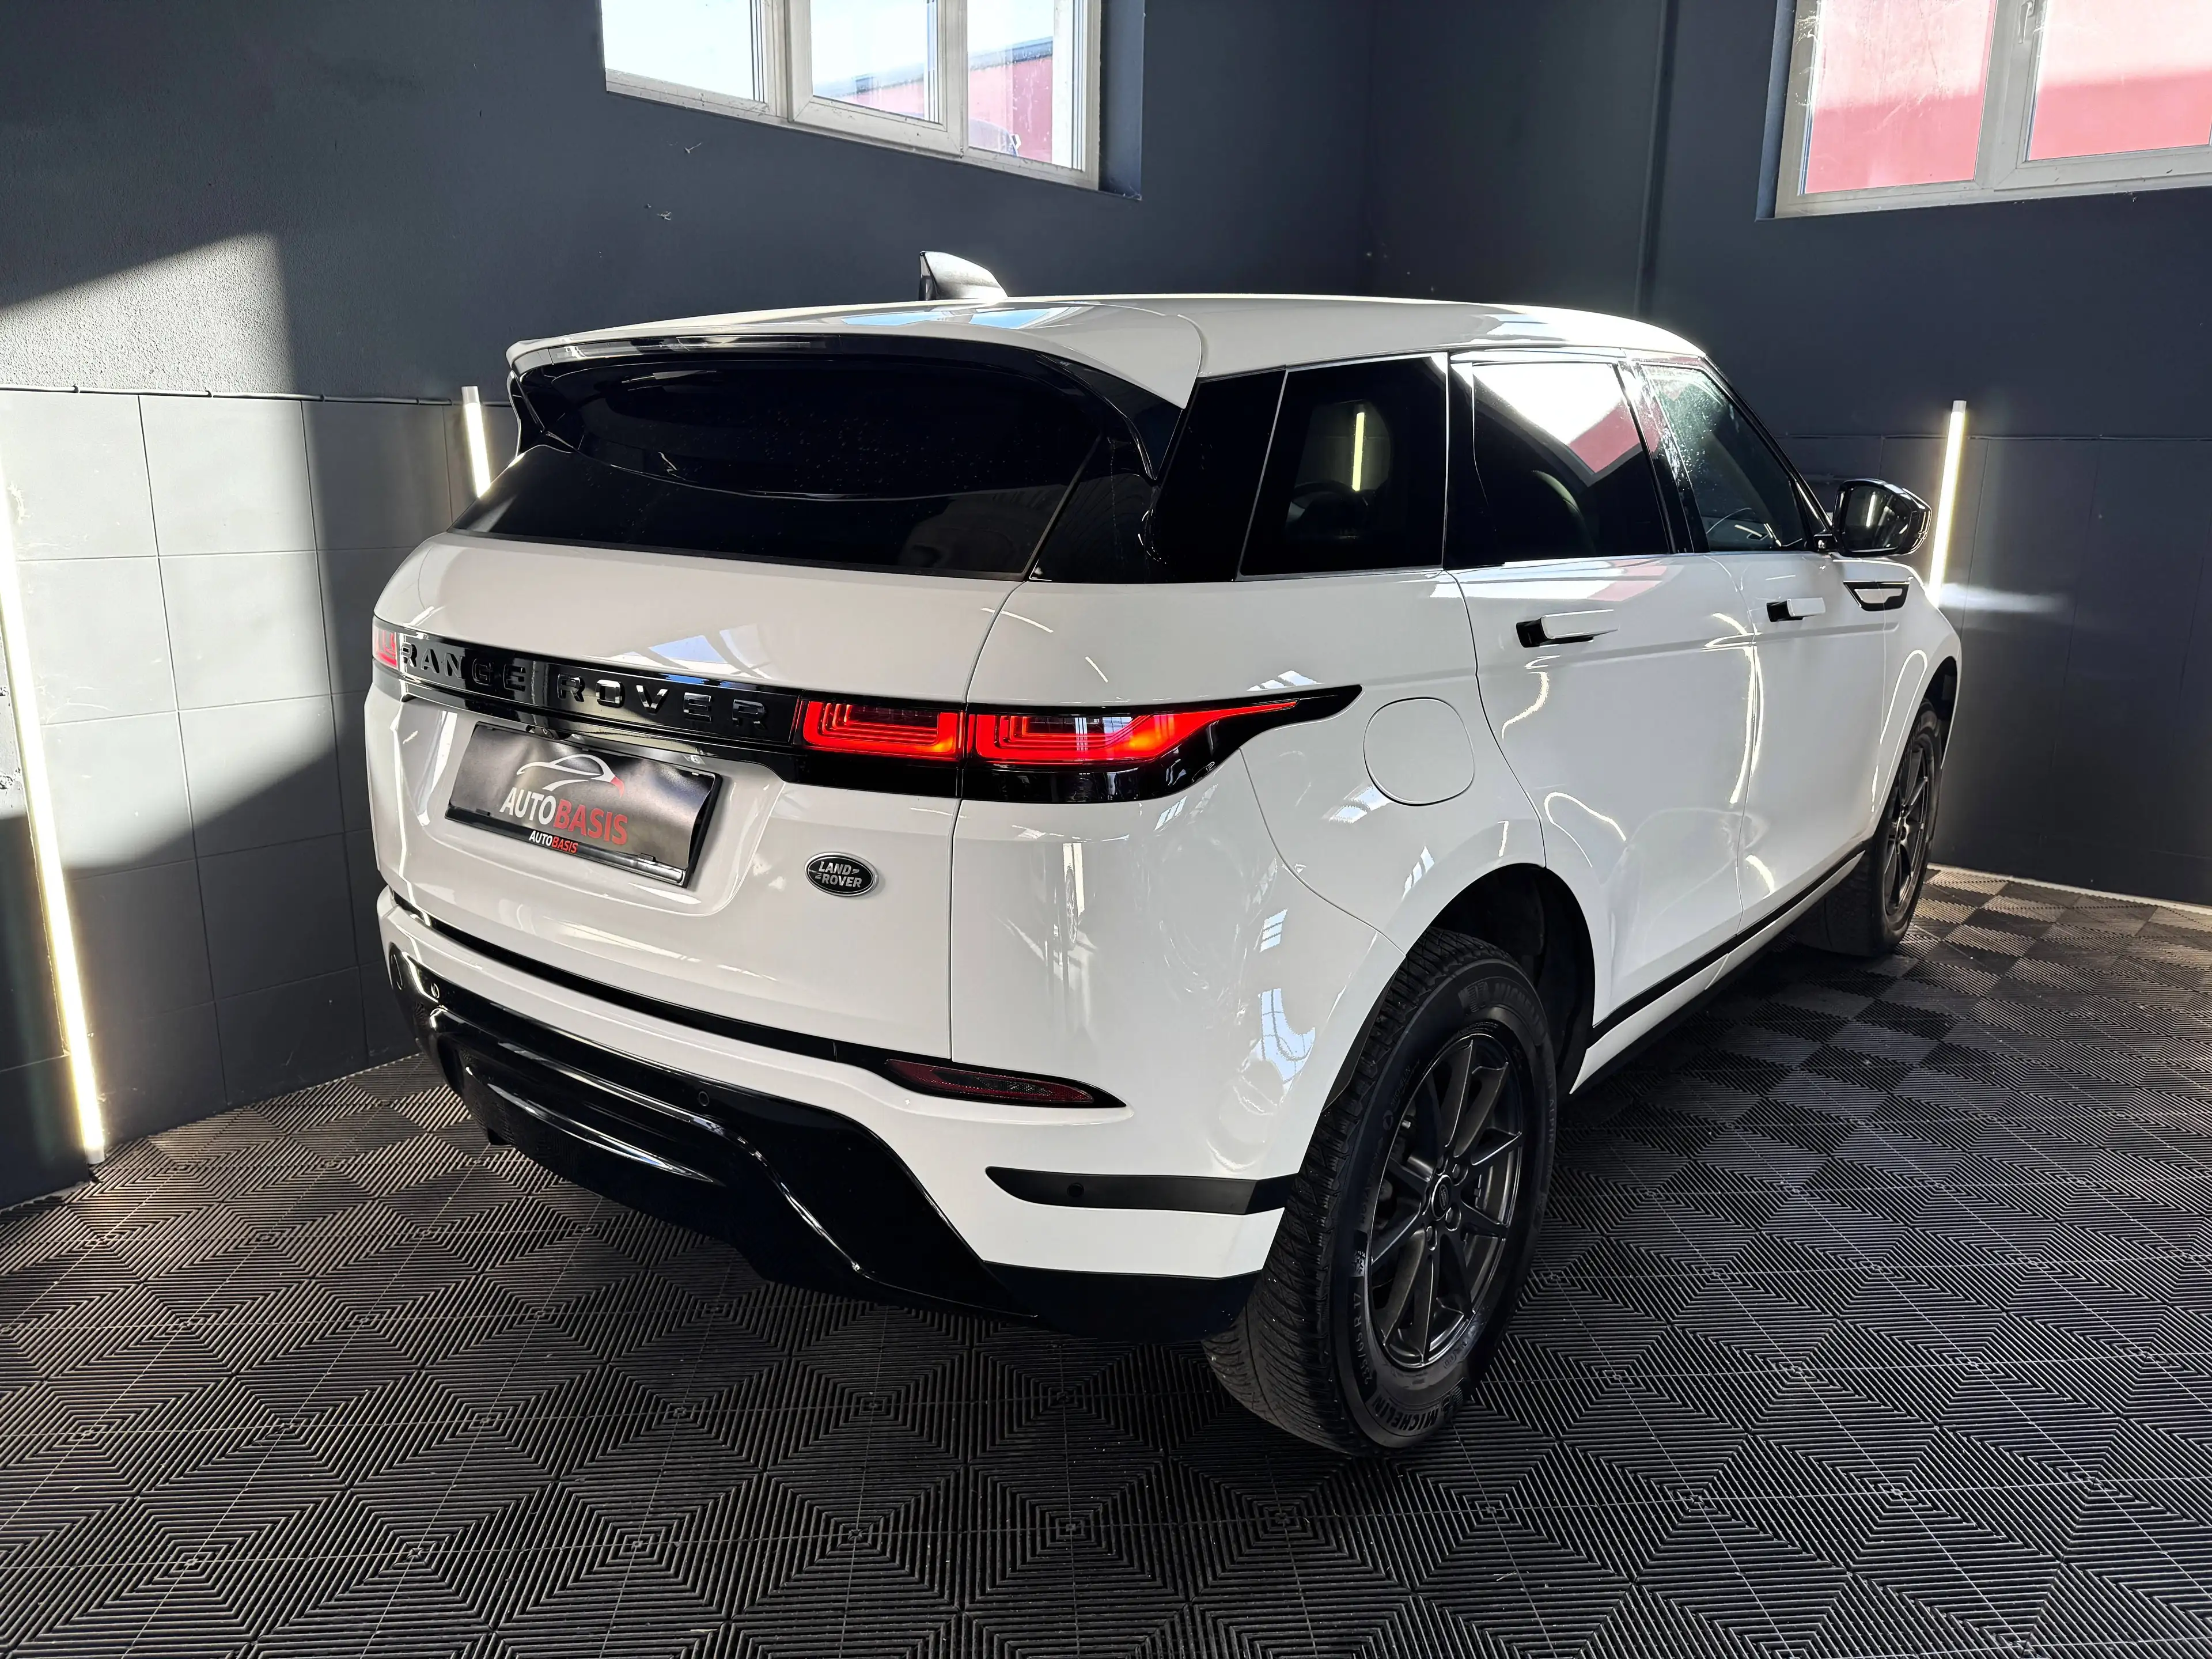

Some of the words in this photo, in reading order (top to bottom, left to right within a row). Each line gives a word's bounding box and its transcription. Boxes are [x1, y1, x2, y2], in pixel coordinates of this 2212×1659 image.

[400, 641, 527, 692] RANGE
[557, 673, 768, 731] ROVER
[499, 787, 628, 846] AUTOBASIS
[528, 830, 578, 854] AUTOBASIS
[818, 861, 852, 876] LAND
[821, 873, 862, 888] ROVER
[1371, 1396, 1440, 1431] MICHELIN
